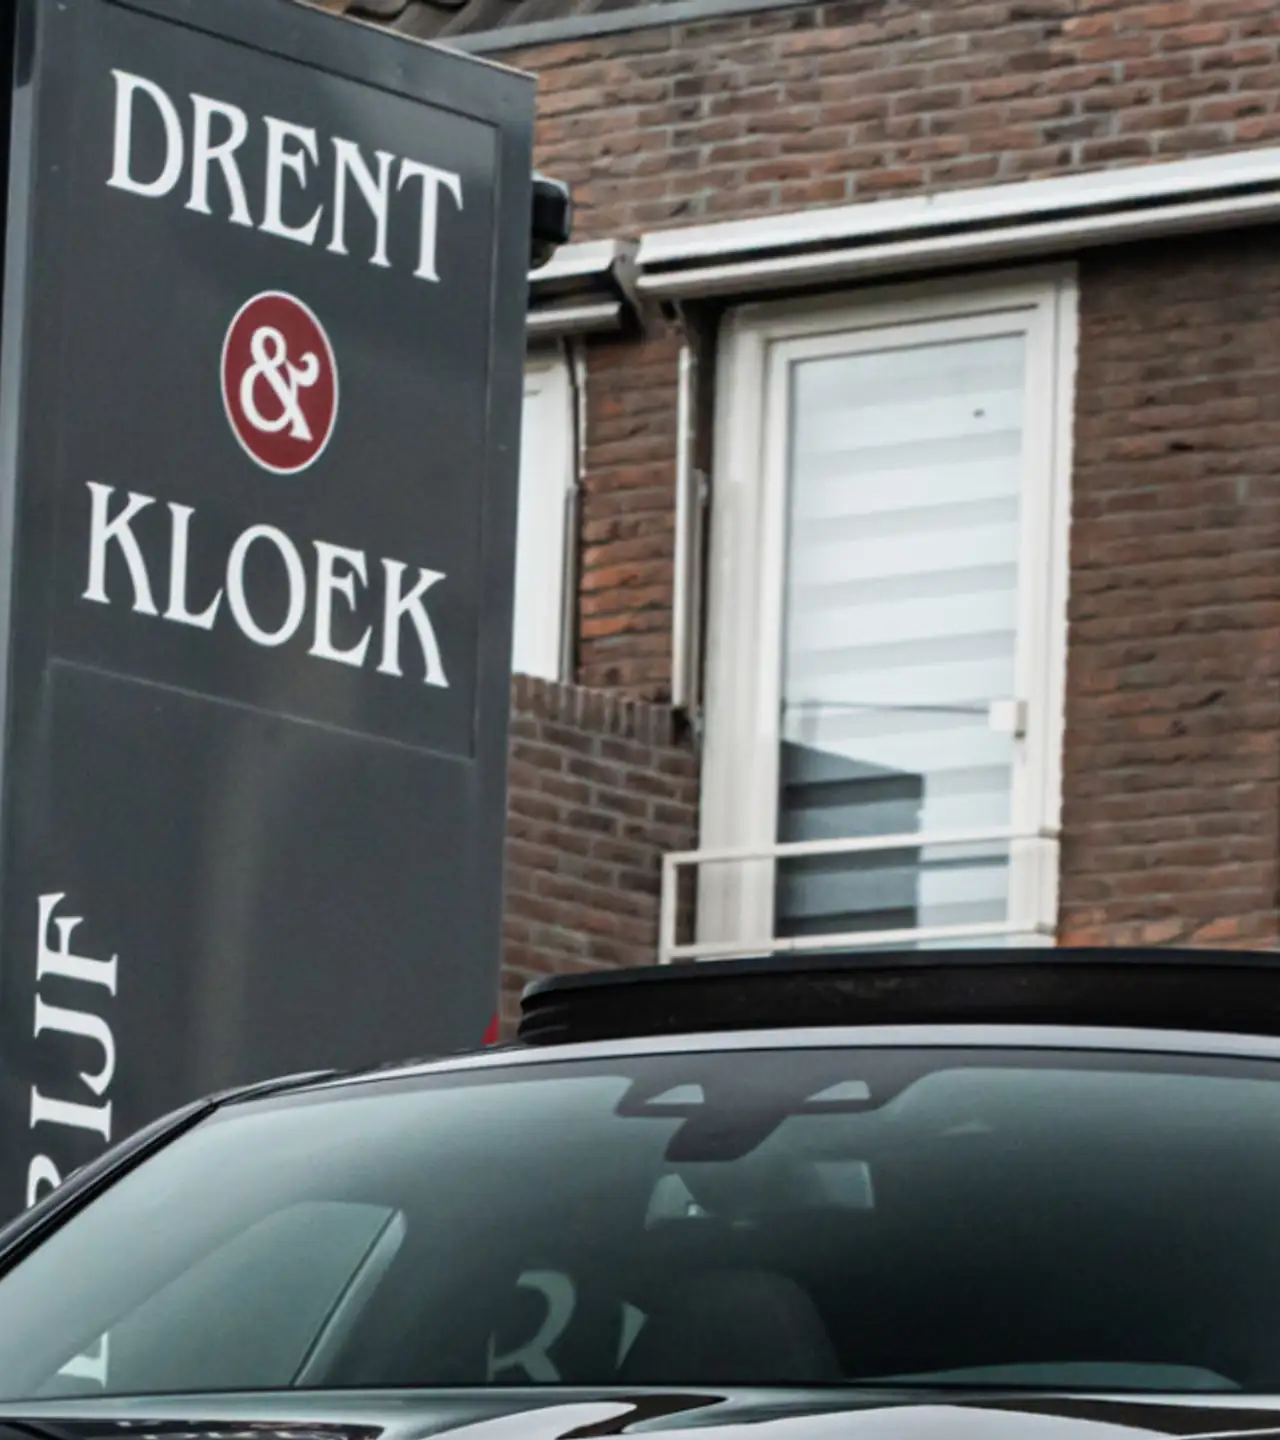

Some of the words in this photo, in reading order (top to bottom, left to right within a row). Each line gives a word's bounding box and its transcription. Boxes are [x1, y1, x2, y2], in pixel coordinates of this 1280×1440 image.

[106, 67, 464, 283] DRENT
[238, 325, 321, 442] &
[81, 480, 450, 689] KLOEK
